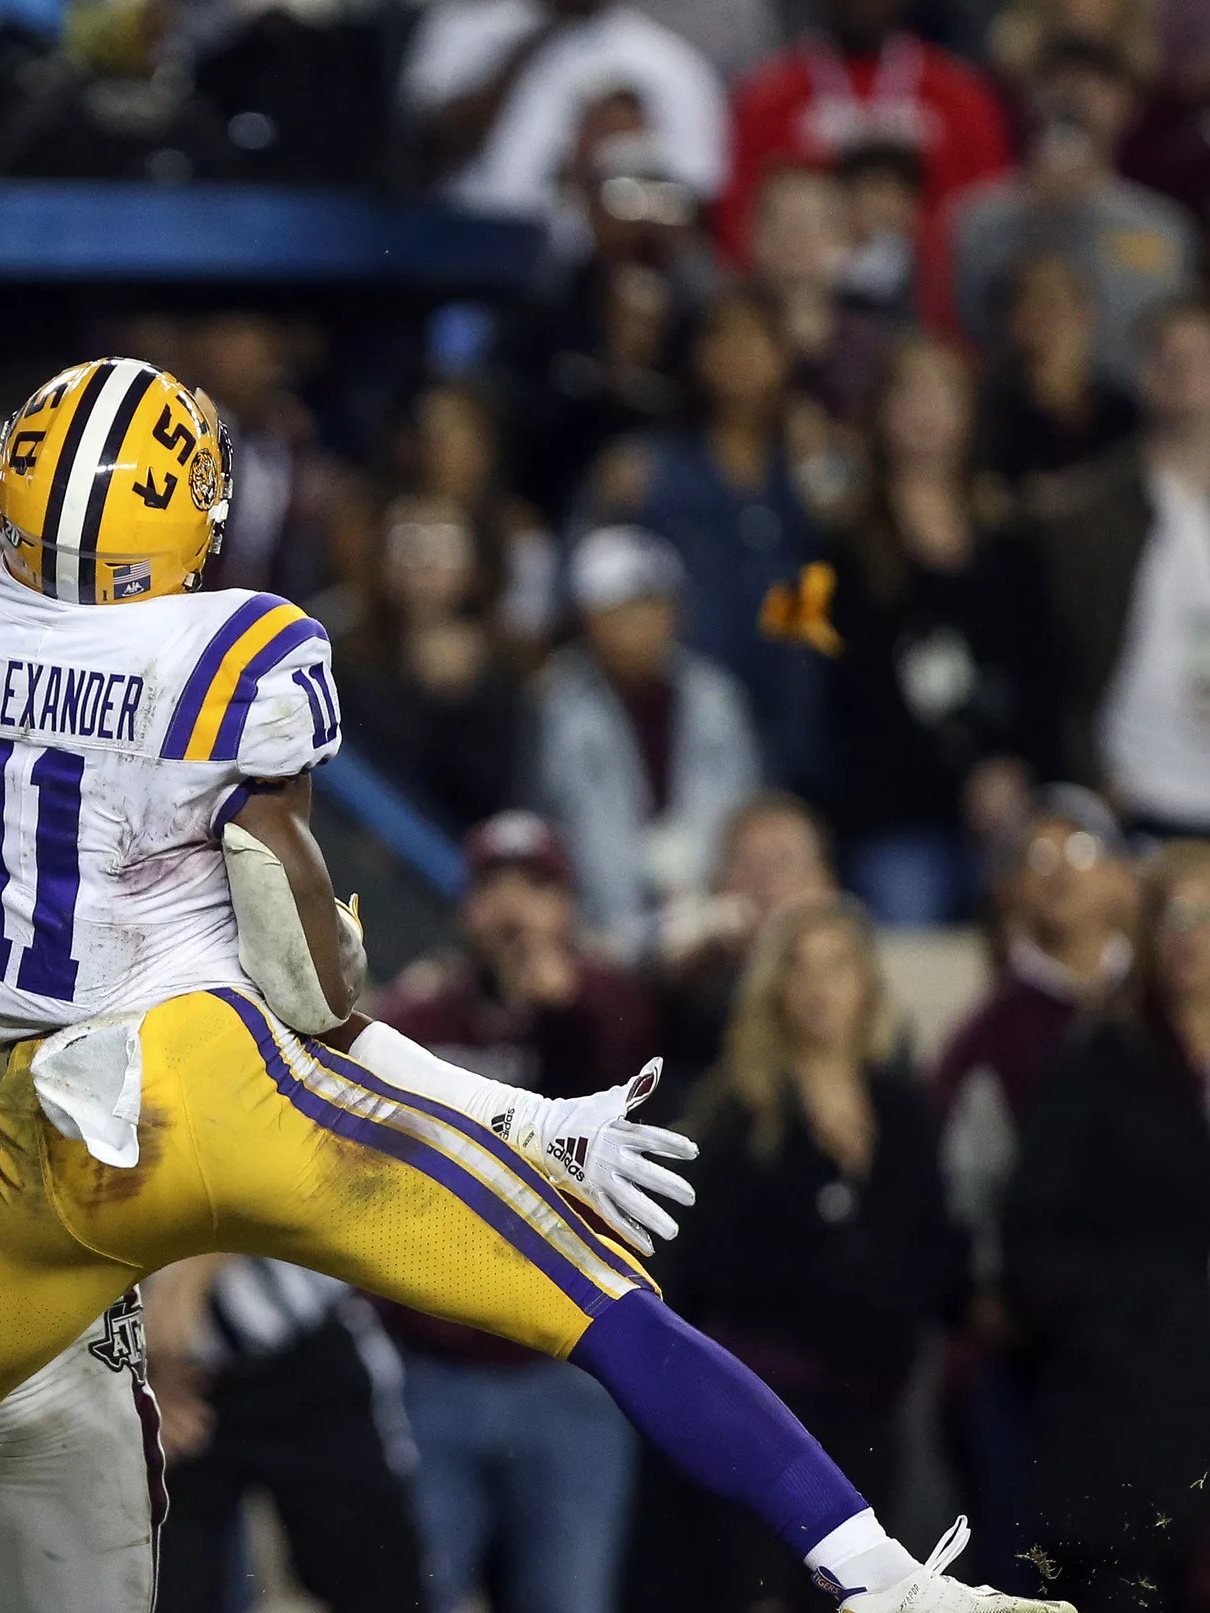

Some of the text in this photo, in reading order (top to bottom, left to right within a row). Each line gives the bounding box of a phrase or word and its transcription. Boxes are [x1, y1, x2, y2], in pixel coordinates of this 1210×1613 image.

[291, 661, 339, 750] 11
[502, 1107, 516, 1141] didas
[812, 1571, 840, 1595] TIGERS
